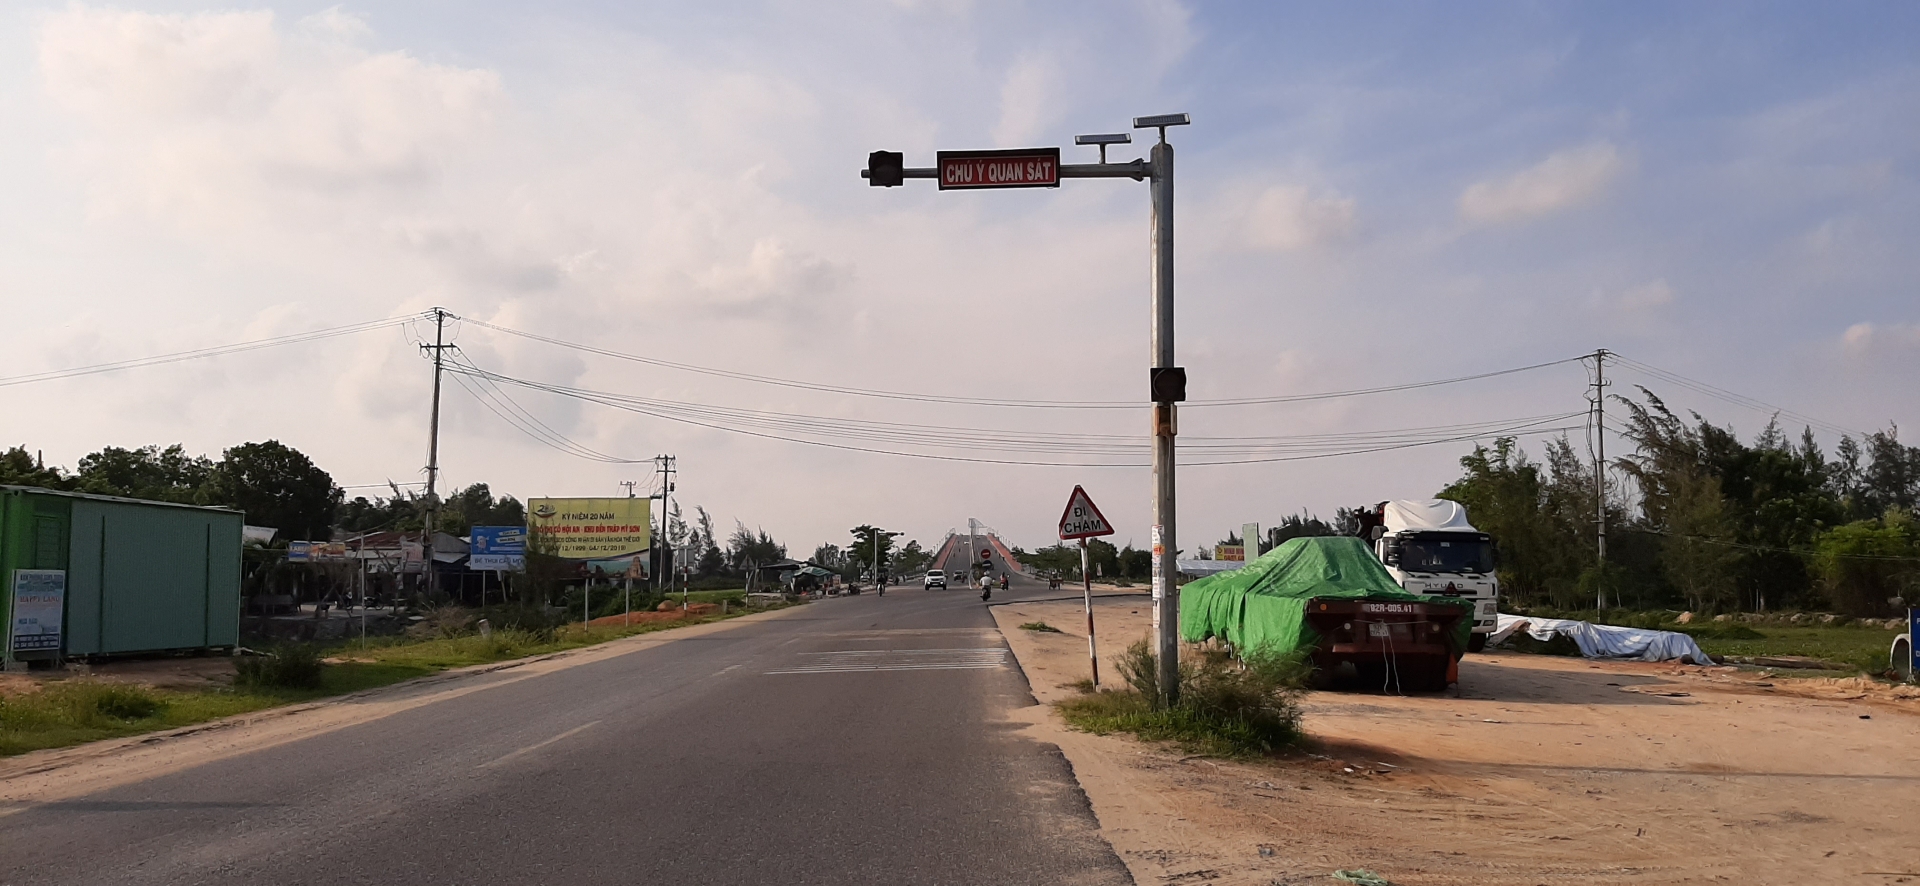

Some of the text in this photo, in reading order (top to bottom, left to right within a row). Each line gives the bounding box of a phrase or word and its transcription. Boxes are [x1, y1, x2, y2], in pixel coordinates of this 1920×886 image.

[946, 158, 1051, 184] CHÚ Ý QUAN SÁT
[590, 512, 599, 520] 20
[1074, 507, 1087, 517] ĐI
